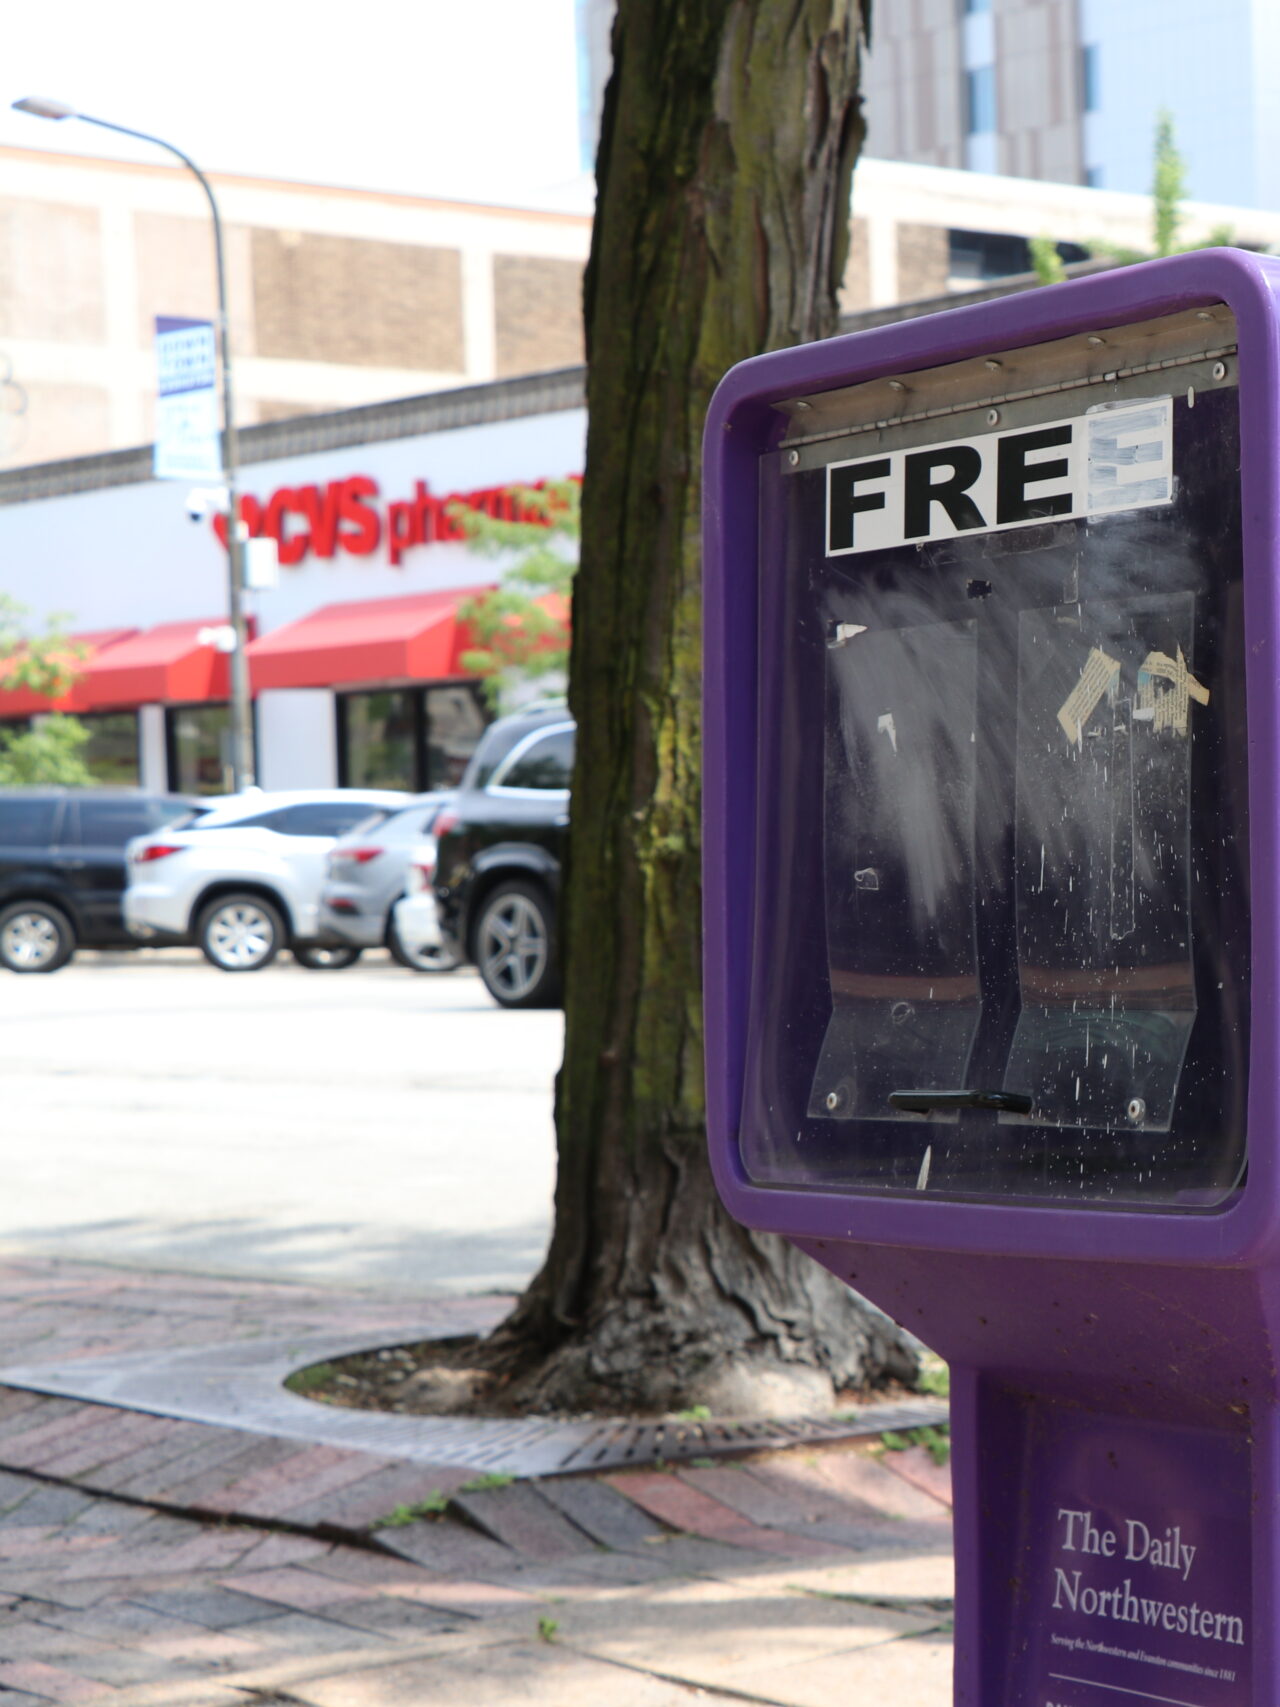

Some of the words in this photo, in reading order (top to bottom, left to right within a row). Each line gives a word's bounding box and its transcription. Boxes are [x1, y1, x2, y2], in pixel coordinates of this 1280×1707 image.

[264, 476, 380, 565] CVS
[1057, 1508, 1116, 1557] The
[1124, 1519, 1196, 1581] Daily
[1052, 1568, 1245, 1645] Northwestern
